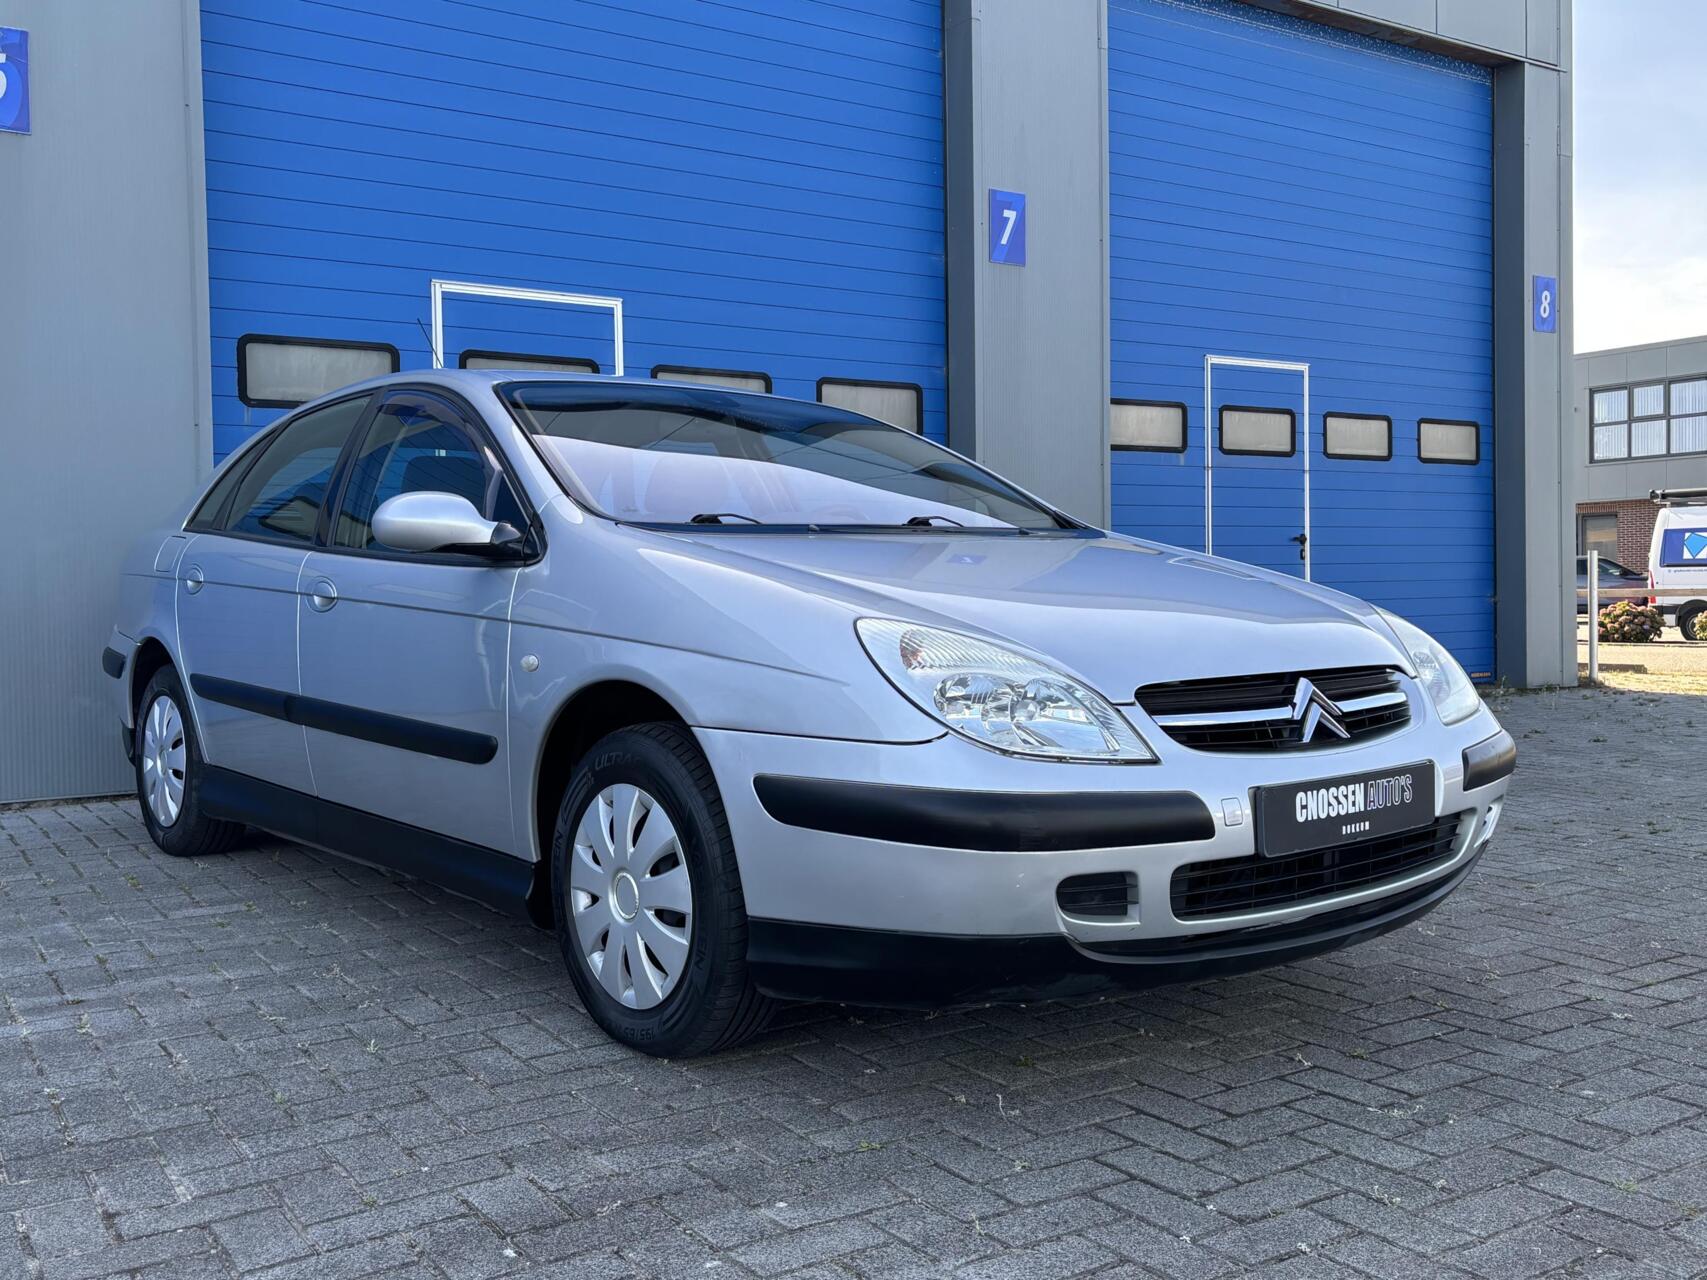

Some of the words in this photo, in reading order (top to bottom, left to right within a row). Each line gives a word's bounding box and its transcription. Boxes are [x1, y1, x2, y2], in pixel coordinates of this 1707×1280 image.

[1001, 209, 1017, 245] 7
[1540, 290, 1550, 318] 8
[1295, 782, 1365, 823] CNOSSEN
[1367, 774, 1412, 810] AUTO'S
